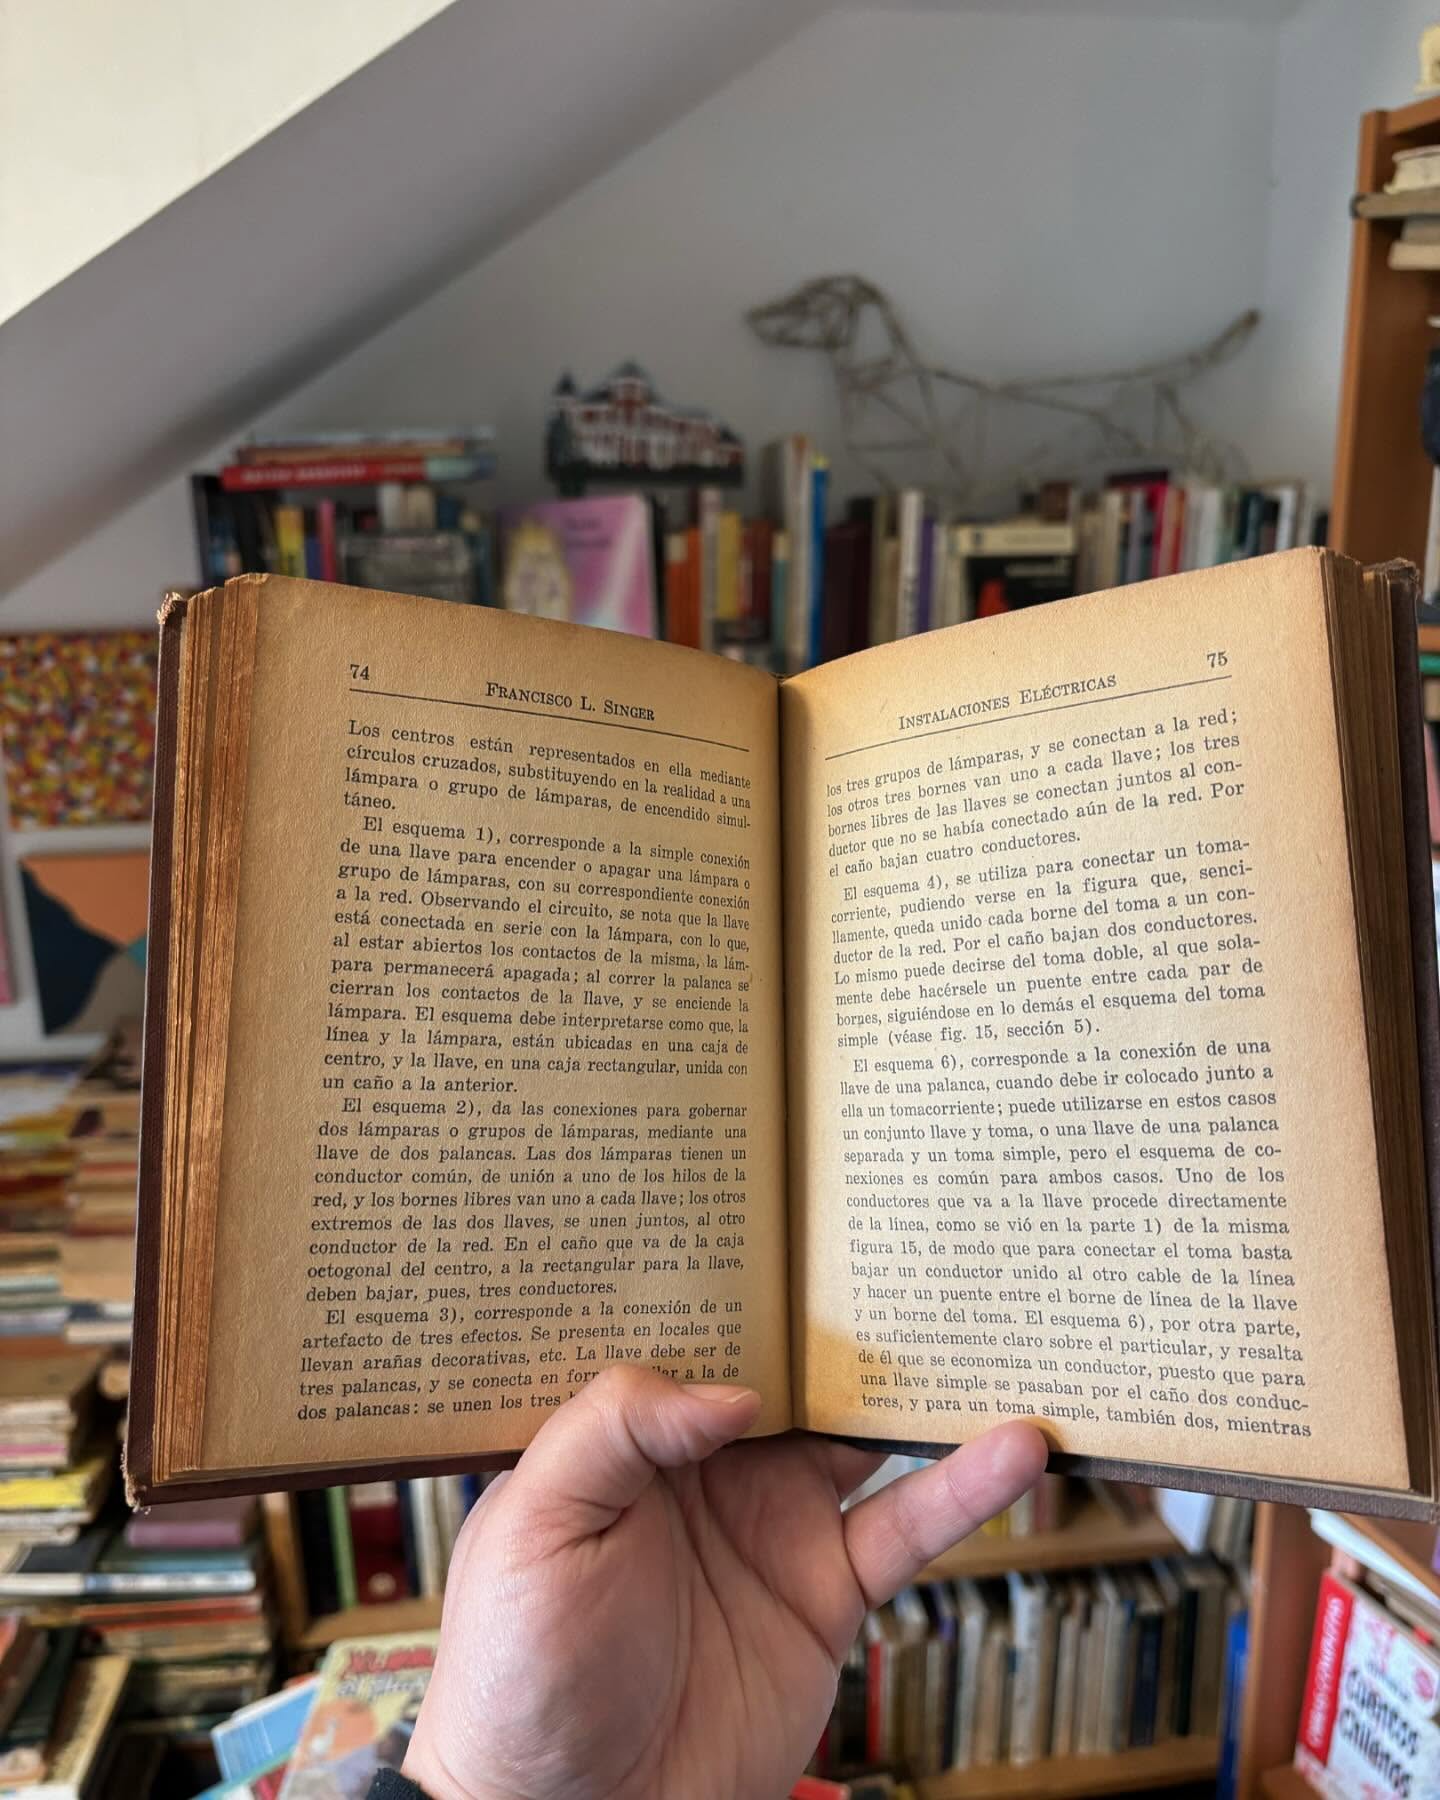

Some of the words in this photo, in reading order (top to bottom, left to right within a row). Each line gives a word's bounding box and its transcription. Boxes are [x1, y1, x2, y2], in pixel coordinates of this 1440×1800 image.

[349, 664, 370, 681] 74
[1206, 651, 1229, 669] 75
[485, 681, 574, 709] FRANCISCO
[580, 695, 597, 712] L.
[603, 699, 656, 722] SINGER
[898, 695, 1011, 732] INSTALACIONES
[1018, 673, 1118, 705] ELÉCTRICAS
[348, 718, 380, 738] Los
[391, 728, 455, 747] centros
[469, 736, 513, 754] están
[529, 745, 636, 769] representados
[643, 760, 660, 773] en
[668, 761, 692, 778] ella
[700, 769, 751, 789] mediante
[827, 784, 842, 797] los
[846, 778, 870, 792] tres
[875, 767, 921, 788] grupos
[926, 760, 943, 776] de
[949, 748, 1024, 771] lámparas,
[1030, 744, 1041, 759] y
[1048, 740, 1065, 753] se
[1072, 726, 1146, 749] conectan
[1154, 723, 1165, 735] a
[1172, 716, 1190, 732] la
[1198, 707, 1237, 728] red;
[343, 791, 396, 810] táneo.
[828, 820, 867, 837] bornes
[870, 813, 909, 829] libres
[914, 806, 930, 821] de
[936, 802, 957, 817] las
[963, 796, 1007, 813] llaves
[1013, 792, 1029, 805] se
[1035, 779, 1109, 801] conectan
[1116, 769, 1172, 792] juntos
[1179, 762, 1196, 780] al
[1203, 760, 1243, 775] con-
[362, 815, 383, 832] El
[392, 822, 466, 840] esquema
[476, 826, 501, 845] 1),
[509, 833, 605, 853] corresponde
[612, 843, 622, 854] a
[629, 840, 643, 856] la
[649, 844, 694, 863] simple
[700, 852, 750, 870] conexión
[337, 864, 391, 882] grupo
[399, 865, 420, 882] de
[426, 867, 510, 891] lámparas,
[517, 878, 545, 892] con
[552, 882, 570, 894] su
[577, 883, 694, 904] correspondiente
[698, 894, 750, 910] conexión
[831, 905, 891, 924] corriente,
[900, 893, 965, 918] pudiendo
[974, 891, 1016, 905] verse
[1026, 887, 1046, 900] en
[1055, 881, 1072, 896] la
[1083, 876, 1138, 894] figura
[1150, 871, 1187, 888] que,
[1199, 859, 1253, 880] senci-
[331, 959, 373, 974] para
[383, 961, 495, 979] permanecerá
[503, 966, 578, 985] apagada;
[586, 968, 600, 984] al
[608, 974, 656, 987] correr
[663, 972, 676, 988] la
[683, 974, 732, 991] palanca
[737, 981, 750, 992] se
[834, 971, 850, 985] Lo
[855, 968, 898, 983] mismo
[904, 961, 945, 982] puede
[952, 957, 1006, 974] decirse
[1012, 952, 1036, 969] del
[1042, 951, 1086, 967] toma
[1093, 944, 1144, 962] doble,
[1152, 940, 1169, 957] al
[1177, 941, 1209, 958] que
[1217, 933, 1261, 951] sola-
[325, 1025, 370, 1043] línea
[378, 1032, 391, 1046] y
[401, 1028, 417, 1044] la
[427, 1029, 502, 1050] lámpara,
[512, 1033, 555, 1049] están
[565, 1034, 633, 1051] ubicadas
[641, 1040, 659, 1052] en
[668, 1041, 694, 1053] una
[701, 1039, 729, 1056] caja
[735, 1039, 749, 1055] de
[837, 1031, 879, 1049] simple
[888, 1029, 933, 1047] (véase
[940, 1026, 967, 1043] fig.
[975, 1024, 998, 1041] 15,
[1006, 1020, 1065, 1038] sección
[1074, 1017, 1100, 1036] 5).
[341, 1097, 362, 1113] El
[372, 1101, 447, 1117] esquema
[455, 1099, 482, 1118] 2),
[491, 1100, 512, 1116] da
[521, 1100, 544, 1116] las
[552, 1101, 638, 1117] conexiones
[646, 1106, 681, 1120] para
[688, 1103, 748, 1120] gobernar
[315, 1144, 359, 1161] llave
[369, 1144, 390, 1161] de
[400, 1144, 429, 1161] dos
[438, 1145, 516, 1164] palancas.
[525, 1145, 556, 1161] Las
[565, 1145, 592, 1161] dos
[600, 1145, 672, 1164] lámparas
[680, 1146, 723, 1161] tienen
[731, 1149, 747, 1160] un
[844, 1147, 905, 1165] separada
[910, 1151, 920, 1165] y
[927, 1151, 948, 1163] un
[954, 1147, 995, 1162] toma
[1002, 1145, 1061, 1164] simple,
[1069, 1148, 1108, 1163] pero
[1115, 1143, 1131, 1160] el
[1139, 1146, 1216, 1162] esquema
[1224, 1141, 1245, 1158] de
[1254, 1145, 1282, 1158] co-
[851, 1261, 889, 1279] bajar
[897, 1267, 917, 1278] un
[925, 1263, 1003, 1279] conductor
[1012, 1264, 1058, 1280] unido
[1067, 1265, 1083, 1281] al
[1092, 1267, 1128, 1282] otro
[1137, 1267, 1181, 1284] cable
[1191, 1268, 1212, 1284] de
[1221, 1268, 1239, 1286] la
[1249, 1269, 1296, 1287] línea
[302, 1332, 383, 1349] artefacto
[391, 1330, 412, 1347] de
[419, 1330, 453, 1346] tres
[460, 1328, 522, 1344] efectos.
[530, 1325, 551, 1341] Se
[557, 1323, 626, 1343] presenta
[633, 1325, 651, 1337] en
[659, 1321, 710, 1337] locales
[716, 1323, 742, 1338] que
[856, 1331, 871, 1342] es
[876, 1329, 997, 1346] suficientemente
[1002, 1331, 1043, 1348] claro
[1049, 1333, 1093, 1351] sobre
[1098, 1336, 1113, 1351] el
[1119, 1338, 1213, 1359] particular,
[1219, 1346, 1231, 1361] y
[1238, 1343, 1304, 1362] resalta
